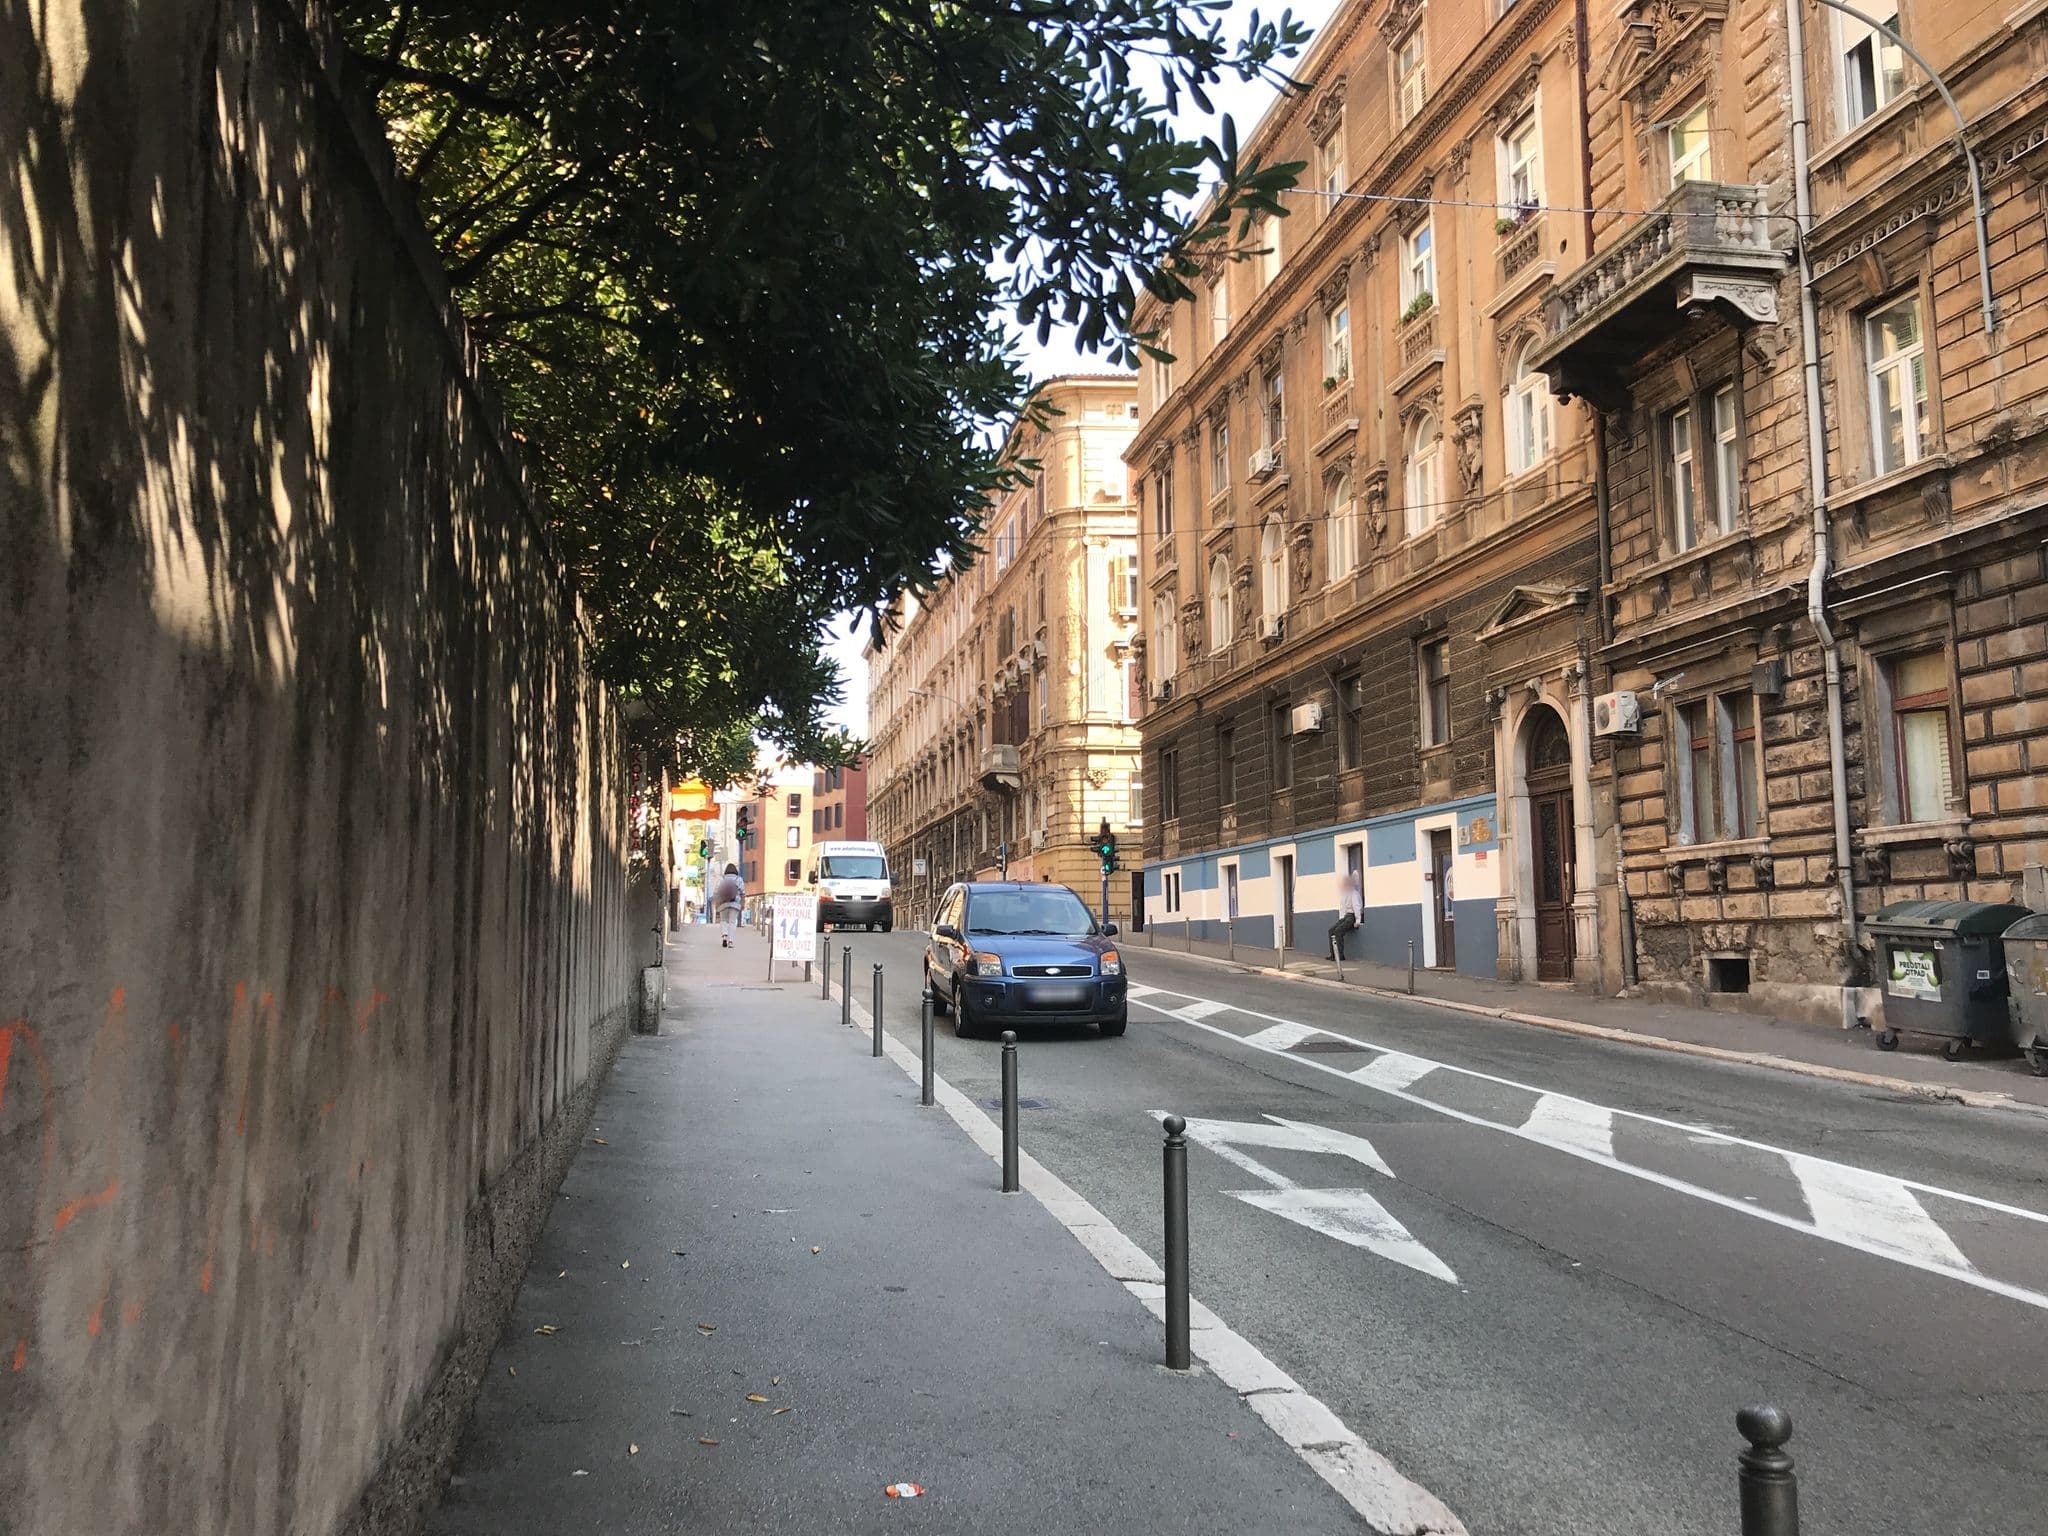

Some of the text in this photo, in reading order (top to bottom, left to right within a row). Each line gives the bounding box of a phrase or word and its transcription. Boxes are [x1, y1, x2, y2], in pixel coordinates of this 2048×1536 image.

[780, 918, 799, 938] 14
[1899, 961, 1930, 970] PREOSTALI
[1905, 969, 1925, 977] OTPAD
